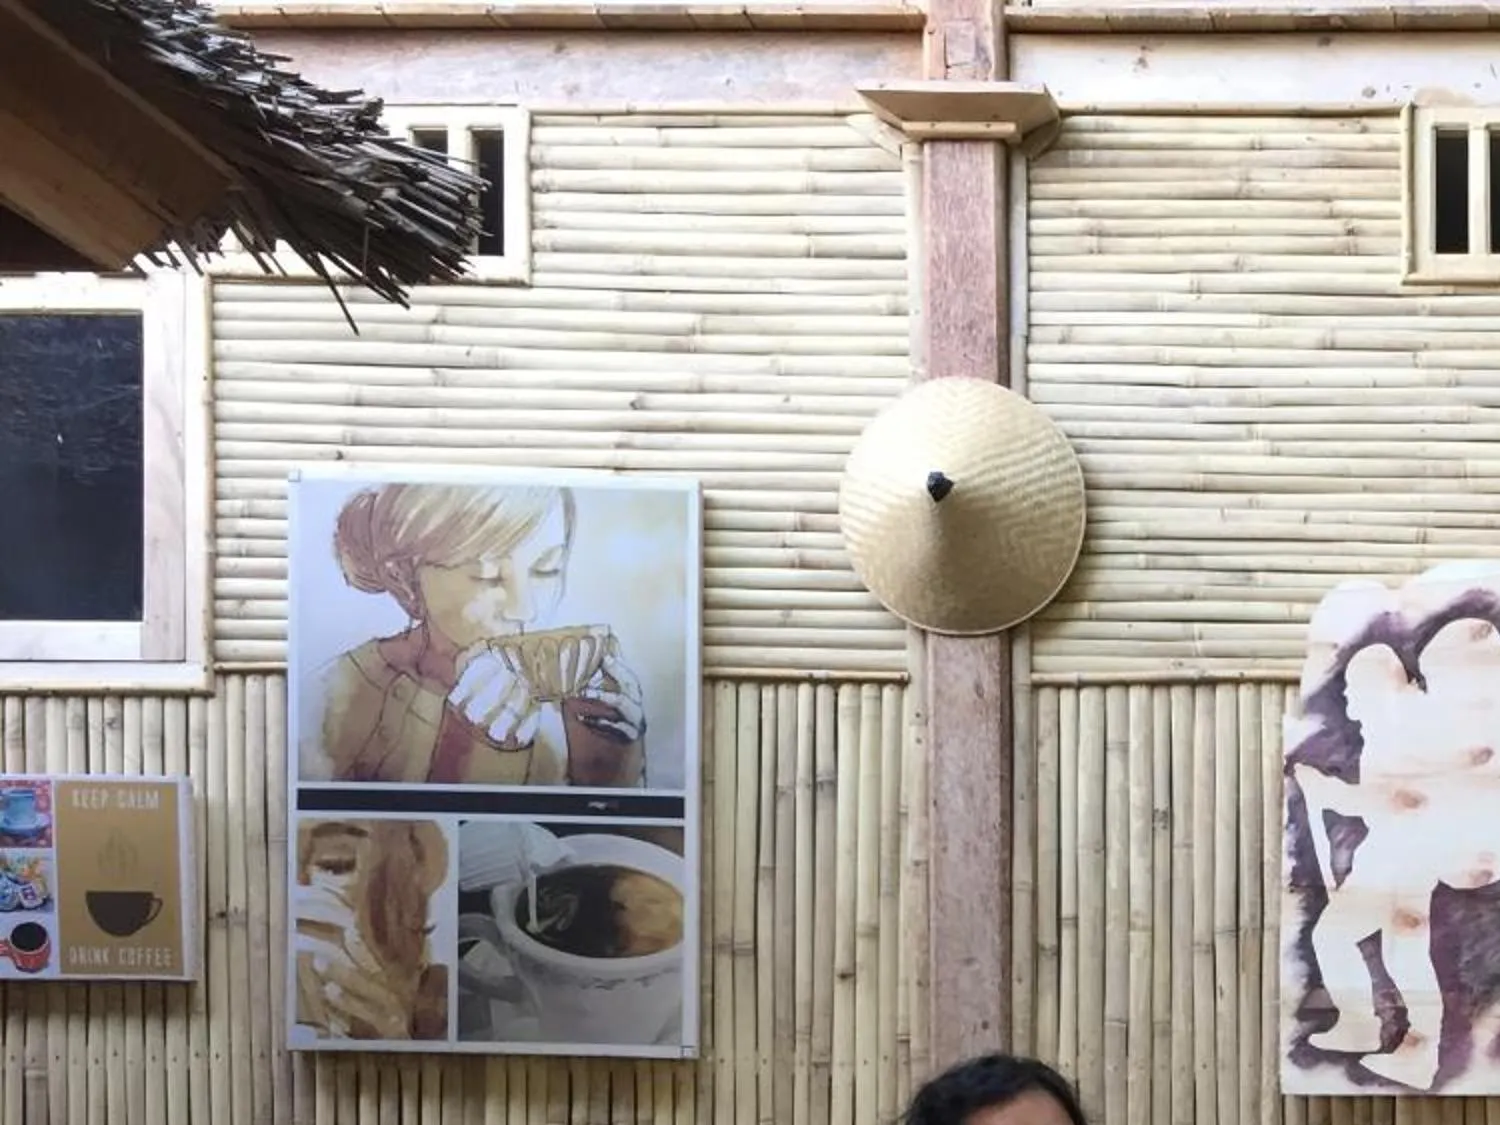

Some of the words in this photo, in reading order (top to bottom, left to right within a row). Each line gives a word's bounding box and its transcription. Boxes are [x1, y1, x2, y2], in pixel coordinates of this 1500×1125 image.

[72, 789, 109, 809] KEEP
[118, 789, 161, 809] CALM
[69, 946, 110, 966] DRINK
[118, 946, 173, 968] COFFEE
